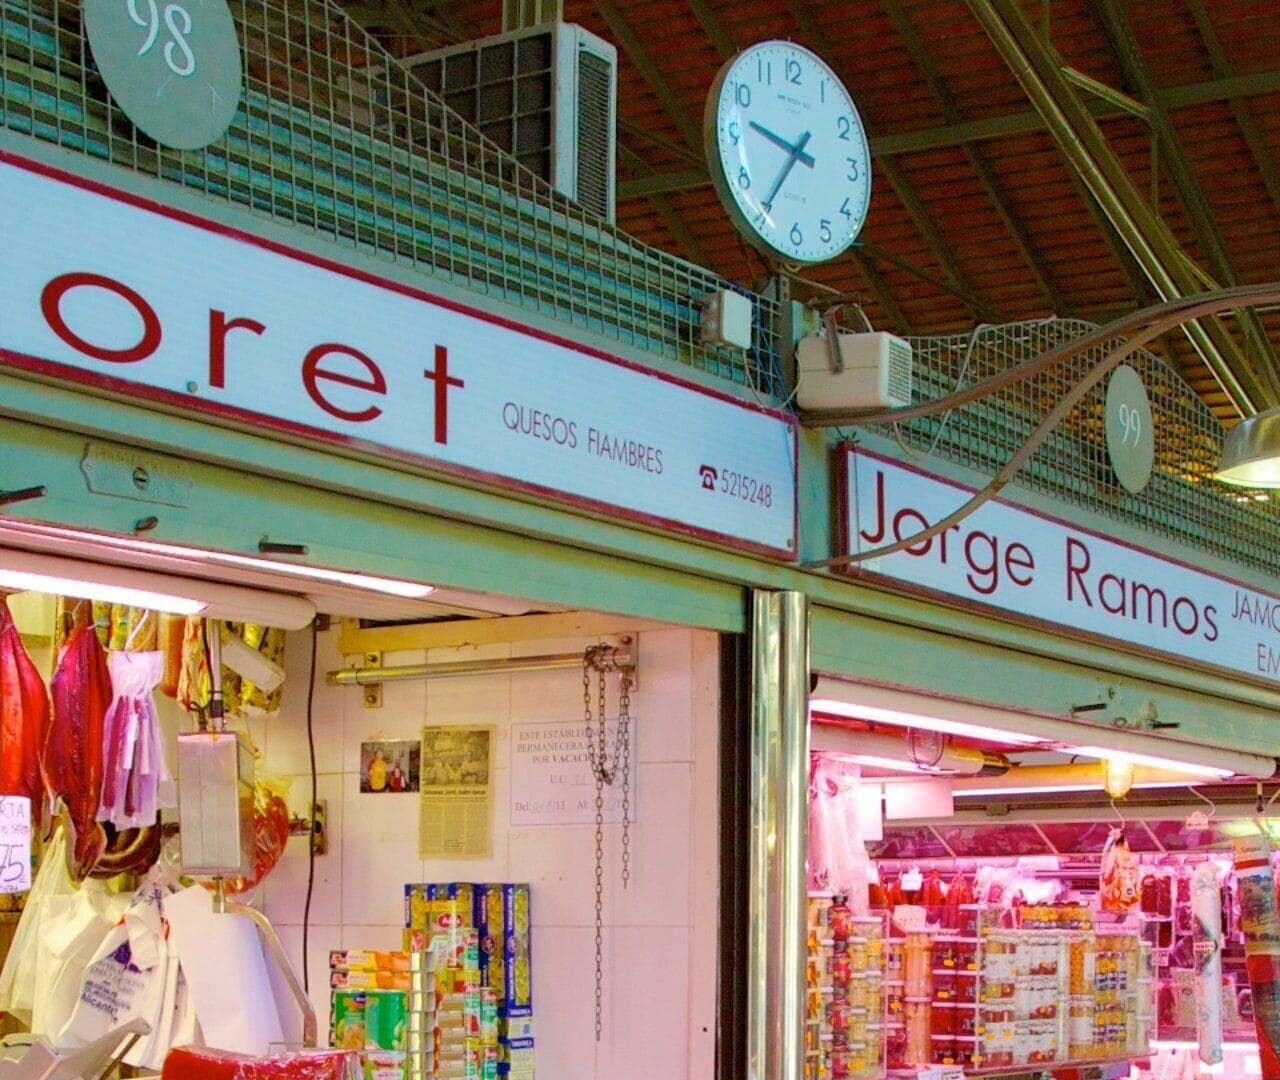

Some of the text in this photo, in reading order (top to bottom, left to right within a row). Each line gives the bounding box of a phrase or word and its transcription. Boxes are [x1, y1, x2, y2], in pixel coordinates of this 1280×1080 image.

[127, 0, 194, 76] 98
[784, 57, 802, 86] 12
[734, 82, 751, 108] 10
[837, 115, 850, 141] 2
[737, 165, 751, 190] 8
[846, 157, 859, 183] 3
[837, 196, 852, 220] 4
[789, 221, 803, 247] 6
[819, 218, 833, 244] 5
[502, 401, 664, 475] QUESOS FIAMBRES
[1117, 403, 1141, 448] 99
[719, 468, 773, 508] 5215248
[860, 470, 1220, 643] Jorge Ramos
